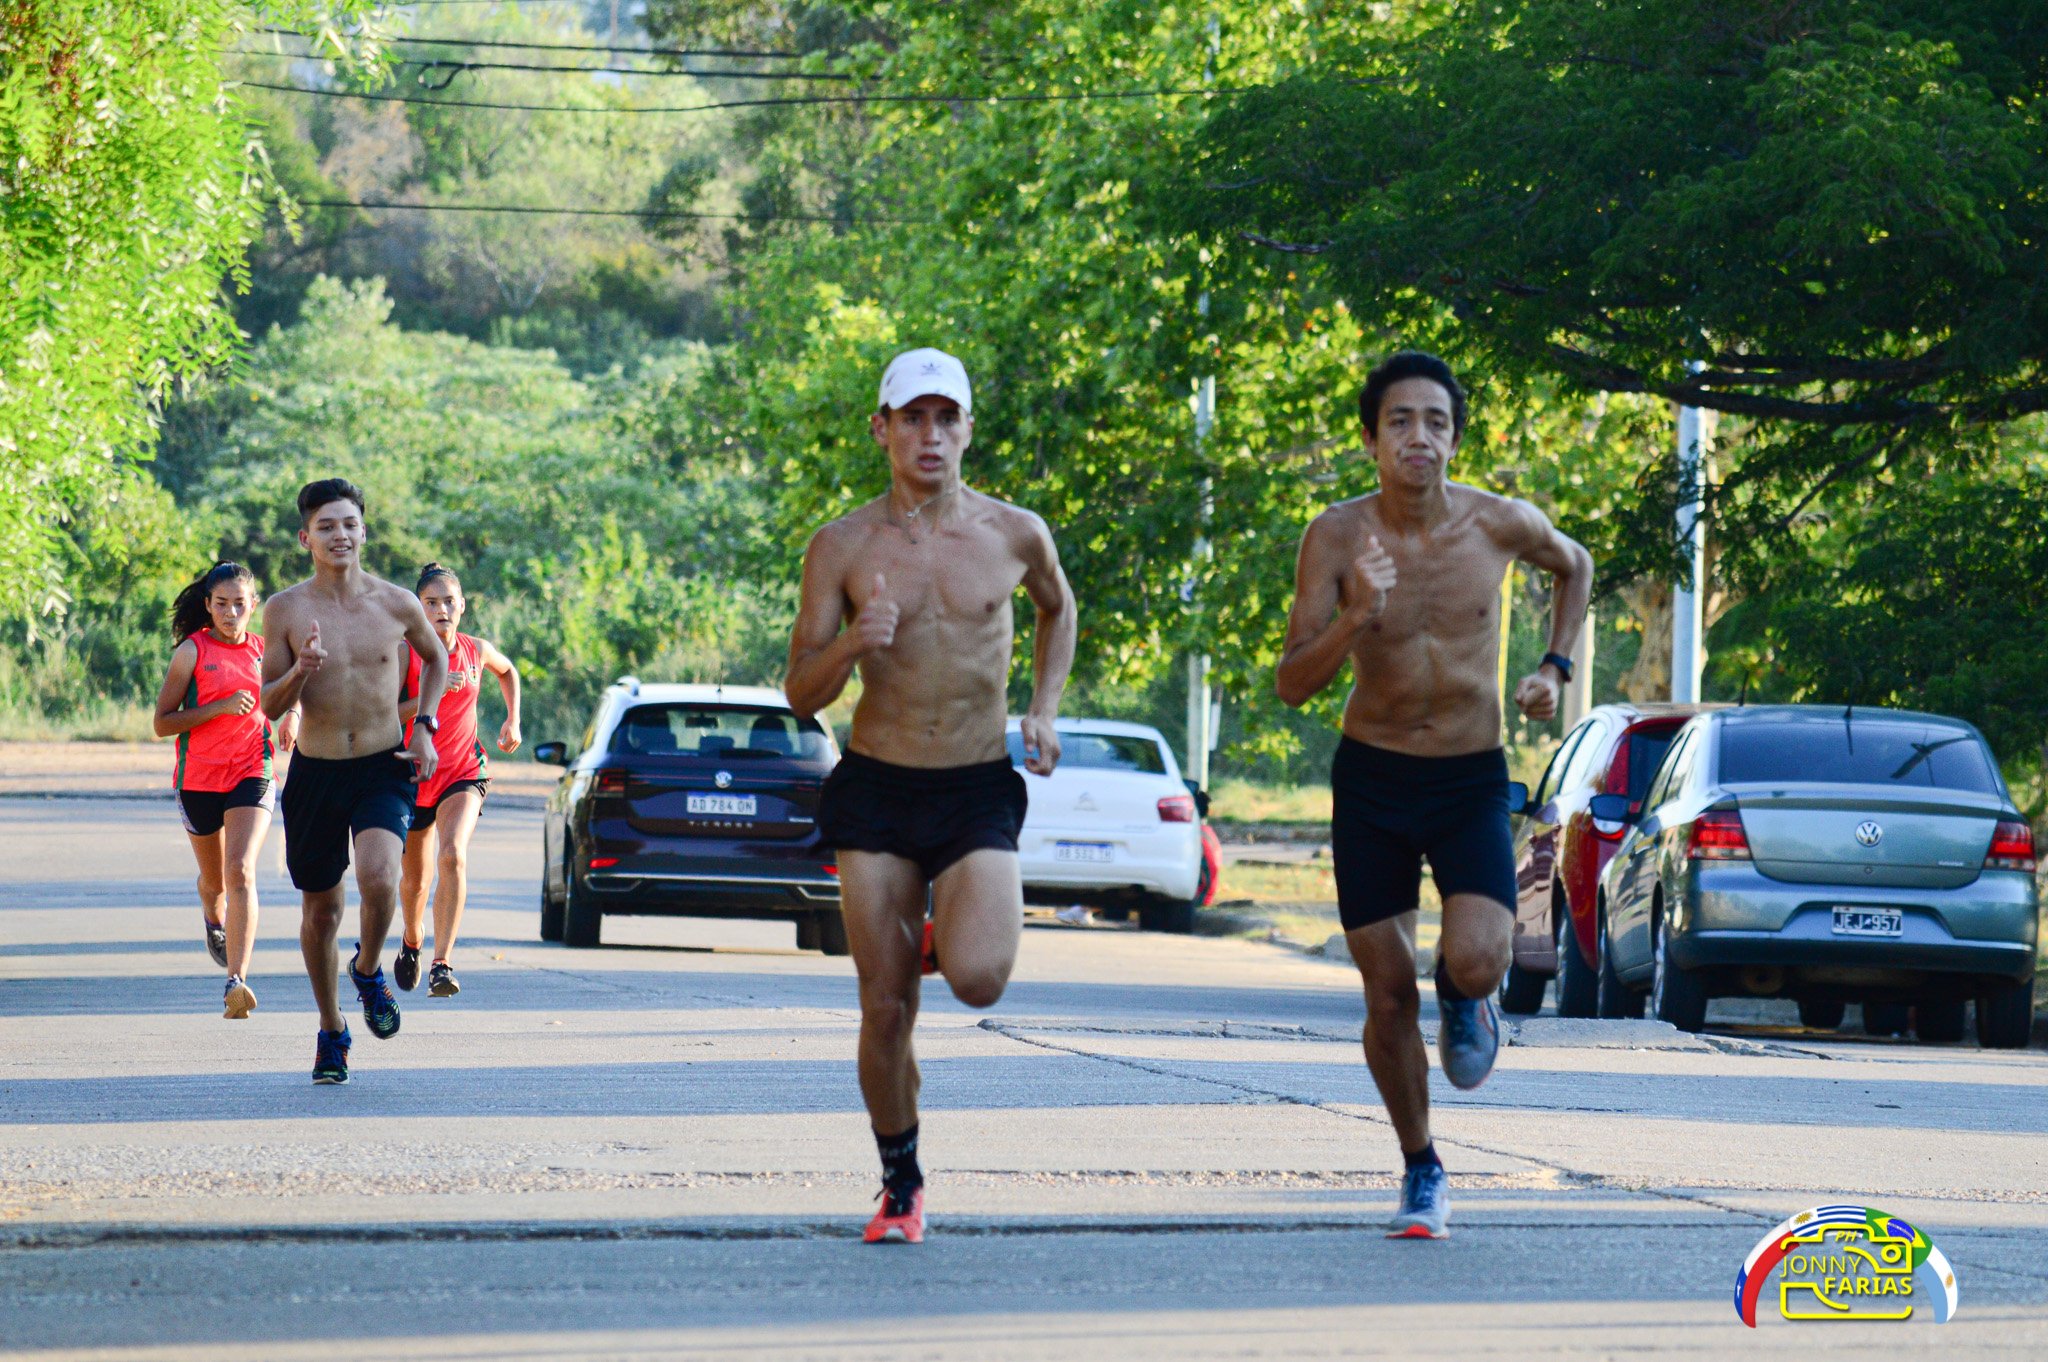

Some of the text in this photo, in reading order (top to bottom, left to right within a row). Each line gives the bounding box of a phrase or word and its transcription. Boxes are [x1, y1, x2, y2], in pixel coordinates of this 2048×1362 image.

[711, 799, 734, 812] 784
[1835, 912, 1900, 932] JEJ 957
